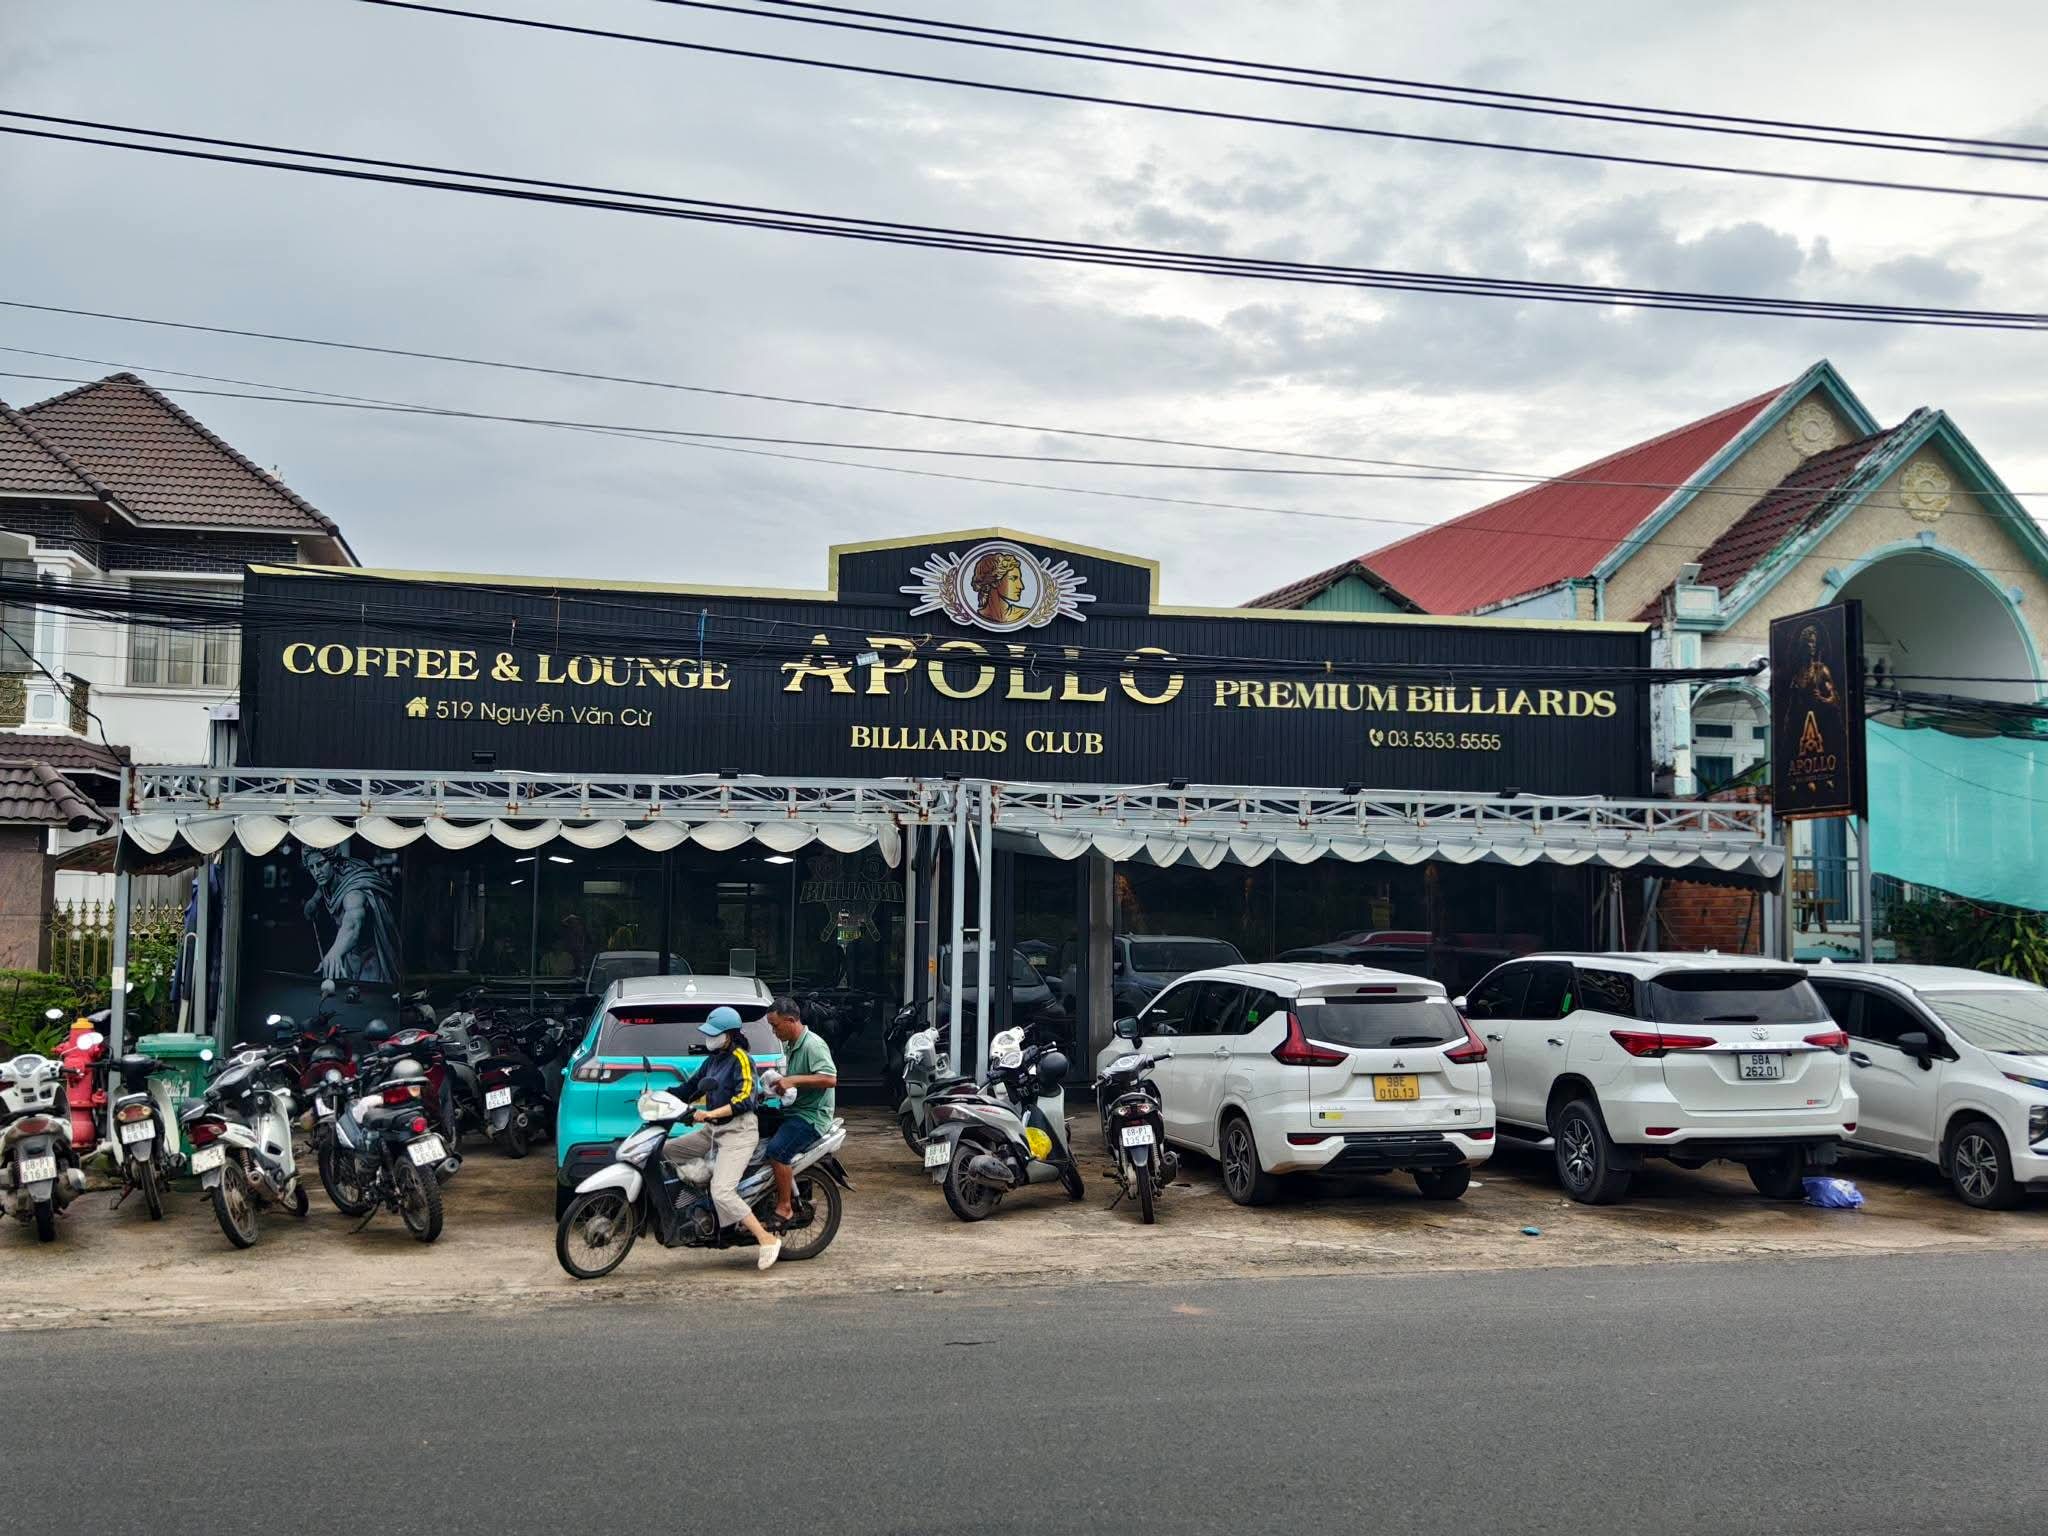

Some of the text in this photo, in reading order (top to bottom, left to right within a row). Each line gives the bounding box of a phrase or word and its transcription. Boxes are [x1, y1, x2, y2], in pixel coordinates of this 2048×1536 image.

[282, 642, 731, 690] COFFEE & LOUNGE
[781, 633, 1185, 705] APOLLO
[1214, 680, 1617, 718] PREMIUM BILLIARDS
[436, 701, 653, 727] 519 Nguyễn Văn Cừ
[850, 726, 1103, 754] BILLIARDS CLUB
[1388, 730, 1501, 751] 03.5353.5555
[1746, 1066, 1778, 1077] 262.01
[1751, 1054, 1770, 1065] 68A
[1380, 1088, 1414, 1099] 010.13
